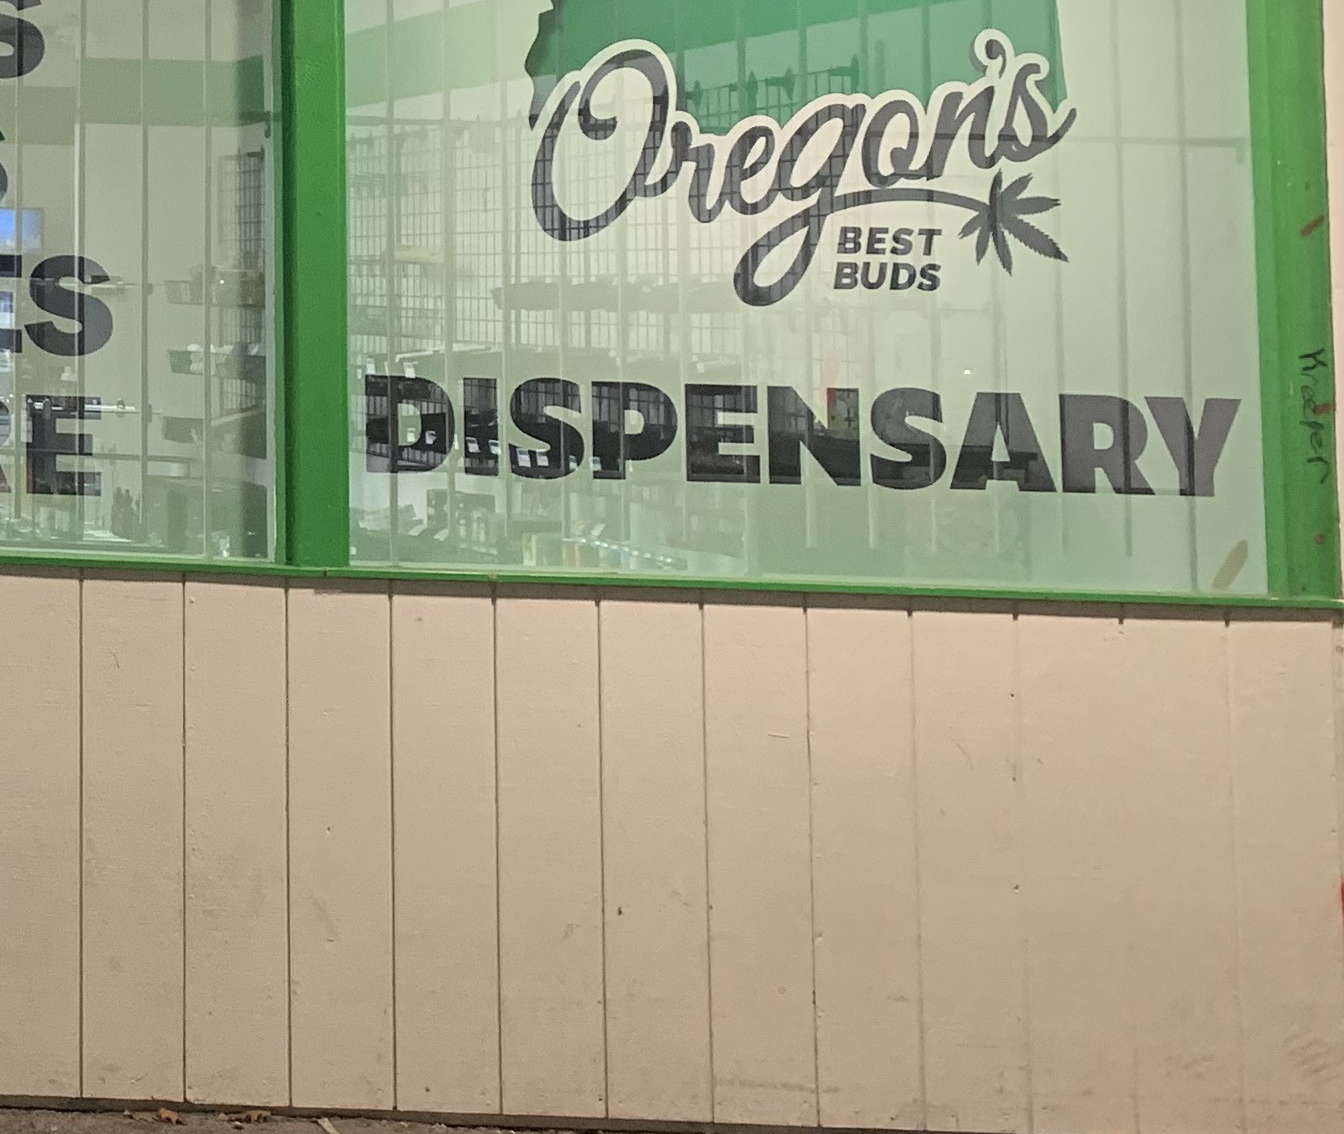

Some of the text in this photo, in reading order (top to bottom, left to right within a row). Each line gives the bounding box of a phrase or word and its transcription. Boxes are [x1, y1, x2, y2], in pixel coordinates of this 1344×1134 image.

[530, 32, 1076, 306] Oregon's
[832, 260, 942, 292] BUDS
[837, 226, 943, 258] BEST
[364, 374, 1241, 497] DISPENSARY
